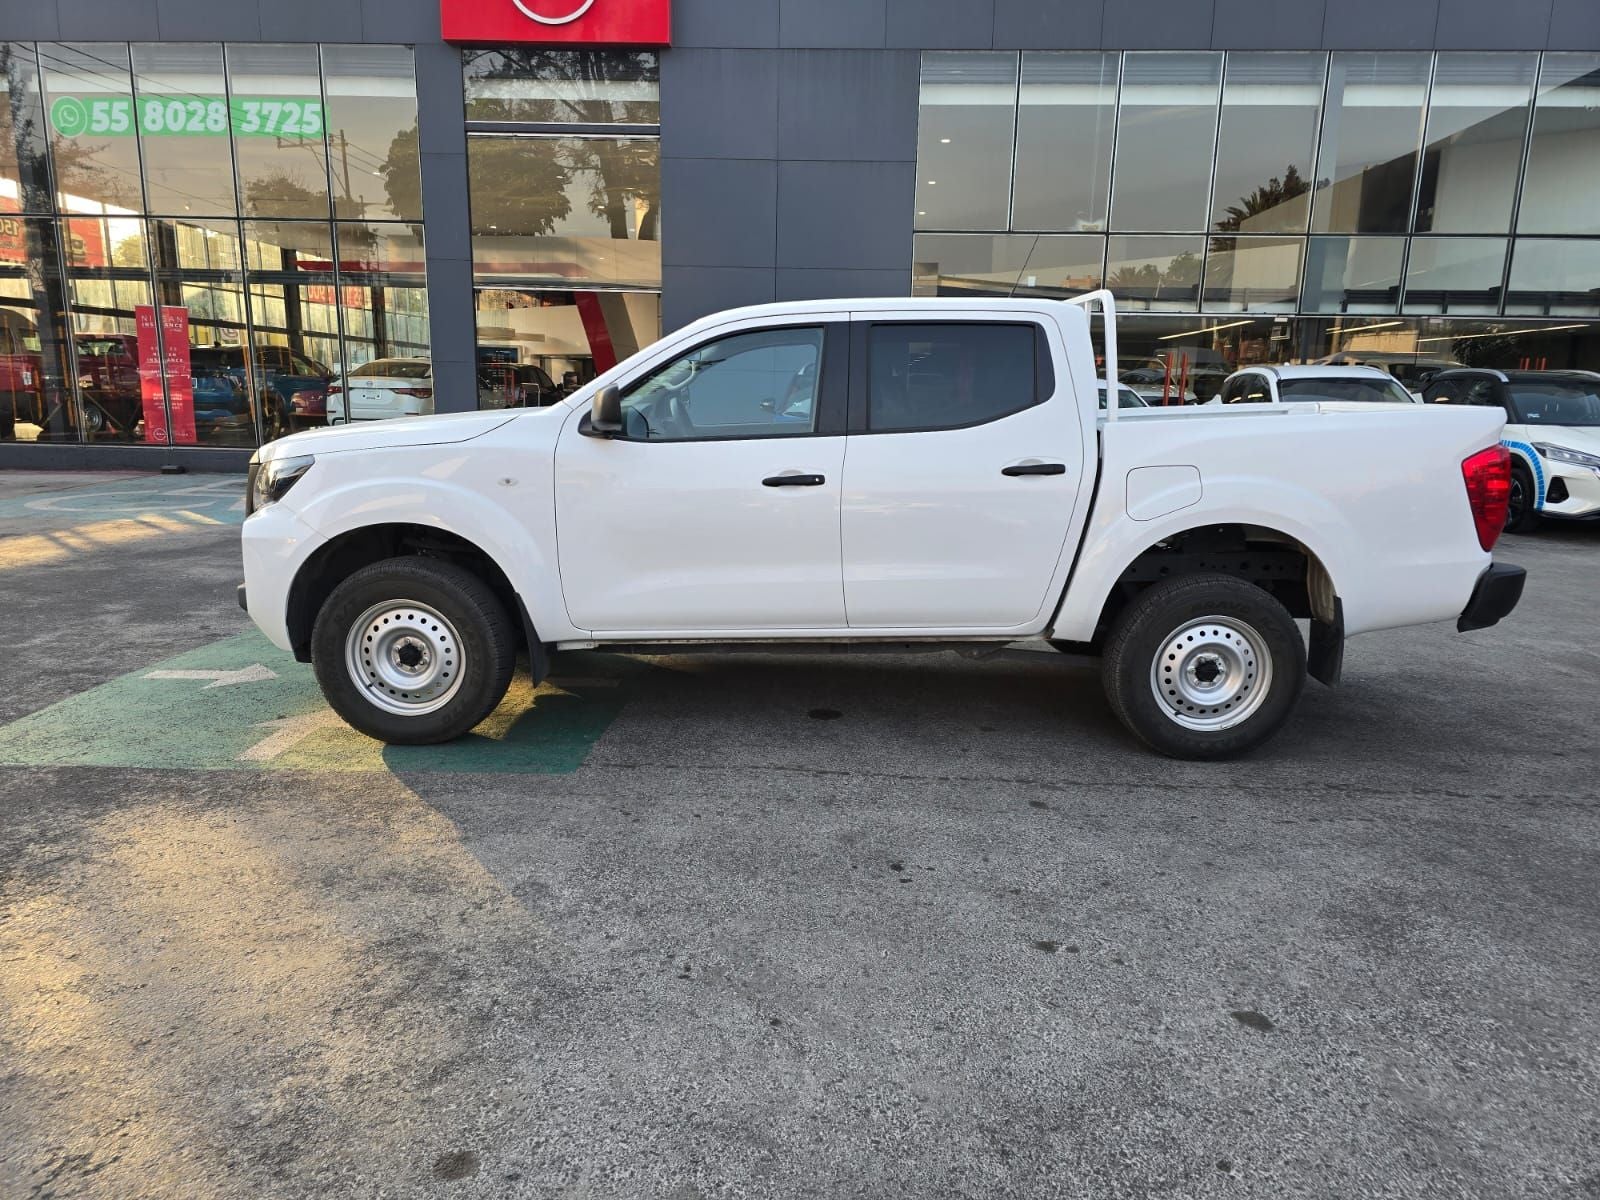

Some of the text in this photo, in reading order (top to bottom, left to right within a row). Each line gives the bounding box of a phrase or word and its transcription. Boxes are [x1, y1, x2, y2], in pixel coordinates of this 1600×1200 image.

[91, 100, 321, 134] 55 8028 3725
